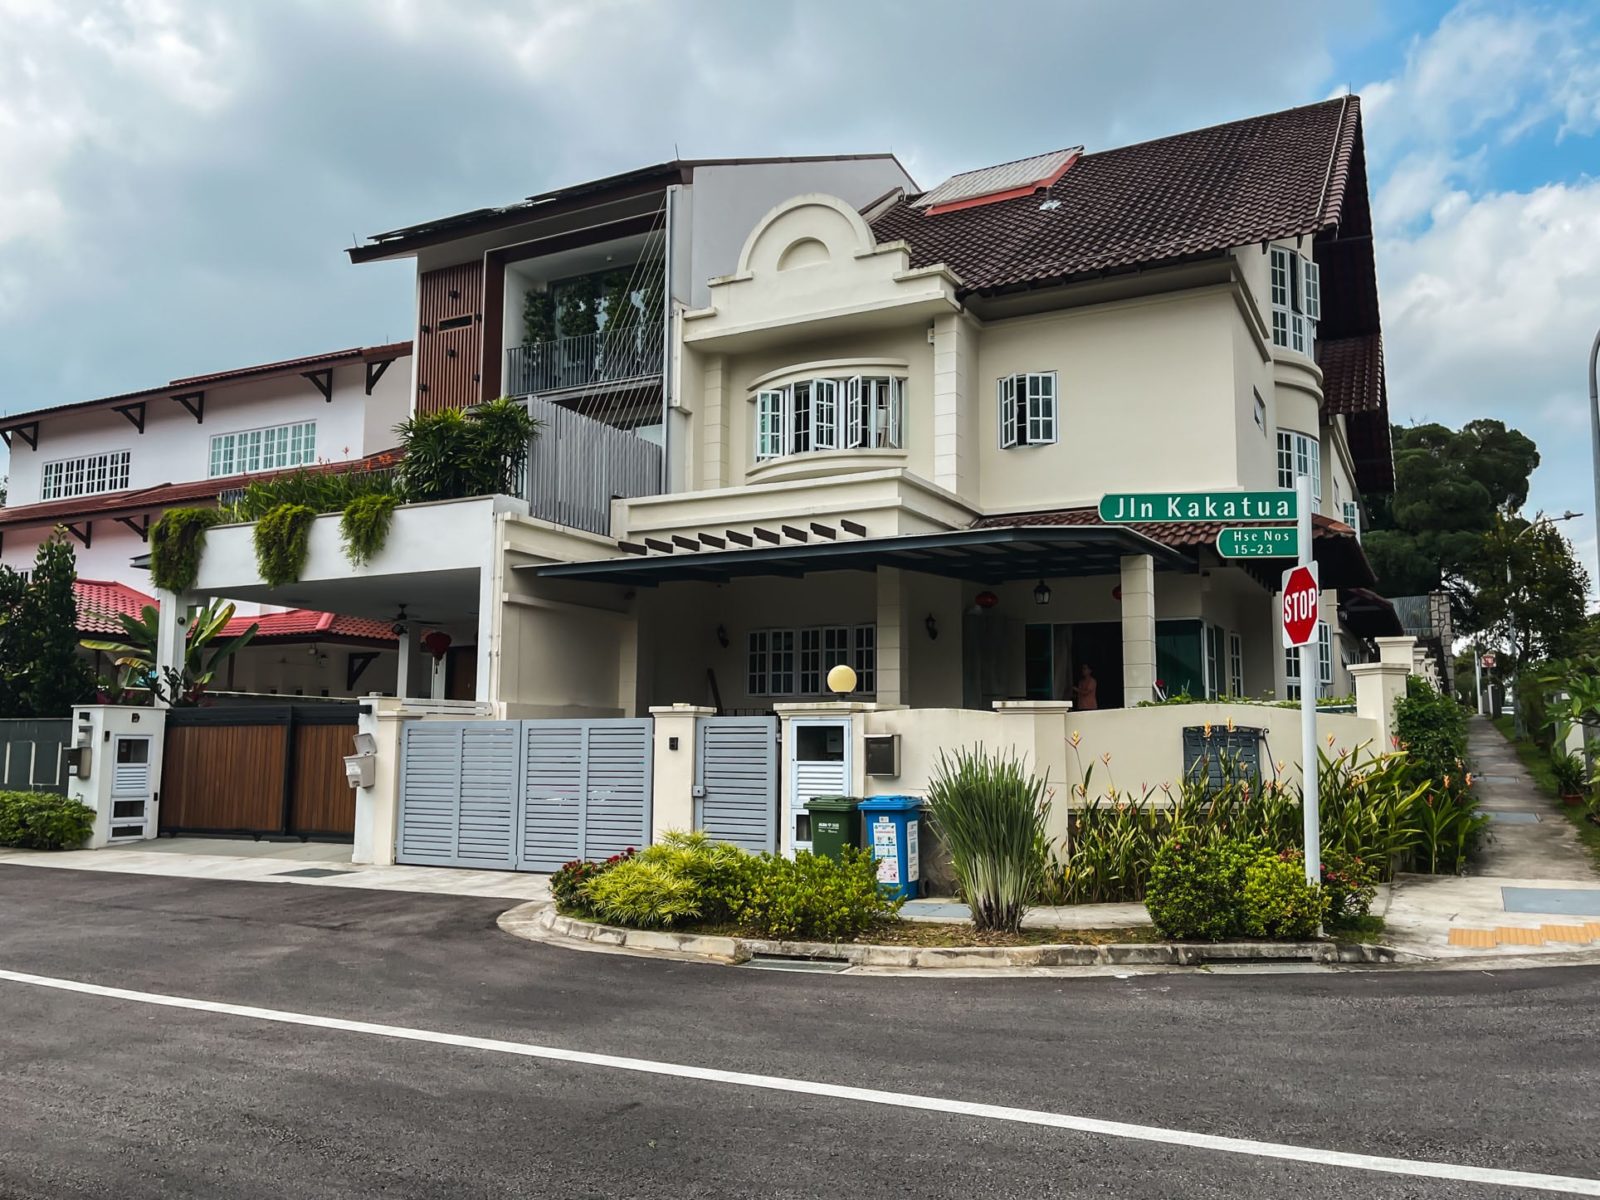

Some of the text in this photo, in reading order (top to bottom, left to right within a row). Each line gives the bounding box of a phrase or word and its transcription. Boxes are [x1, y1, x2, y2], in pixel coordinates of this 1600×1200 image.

[1114, 496, 1289, 519] Jln Kakatua
[1233, 530, 1290, 542] Hse Nos
[1234, 544, 1273, 555] 15-23
[1284, 587, 1316, 624] STOP
